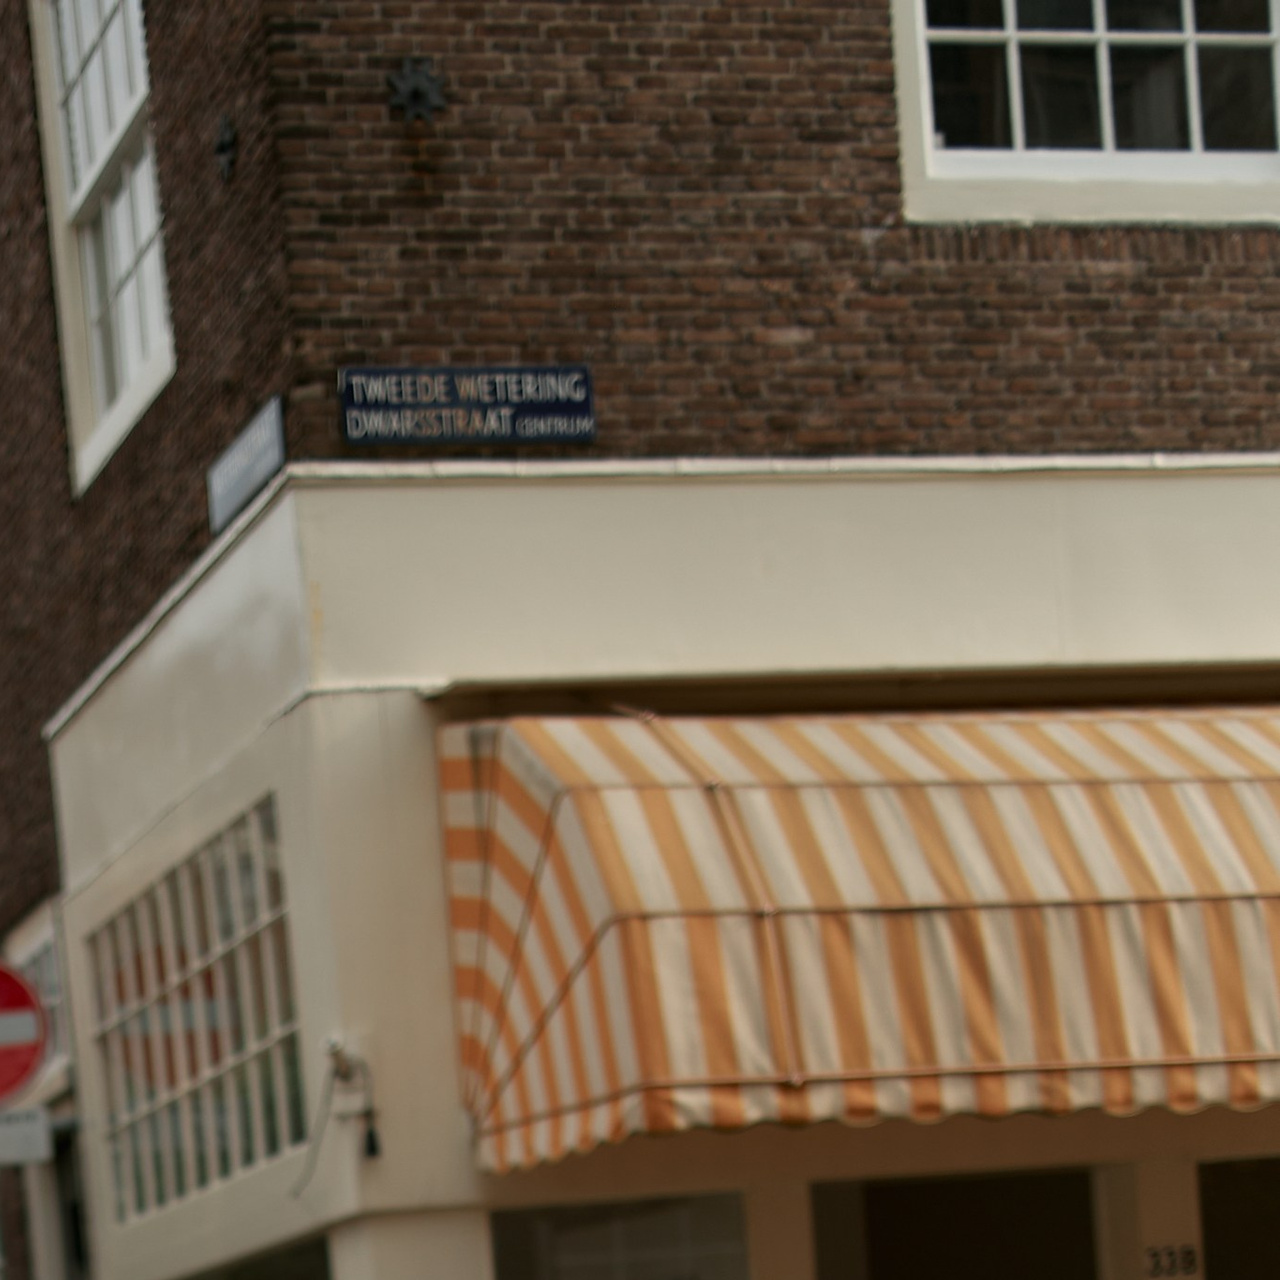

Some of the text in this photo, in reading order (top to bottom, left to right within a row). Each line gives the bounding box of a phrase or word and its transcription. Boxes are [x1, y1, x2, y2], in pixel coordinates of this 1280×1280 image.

[351, 371, 587, 404] TWEEDE WETERING
[346, 408, 515, 439] DWARSSTRAAT
